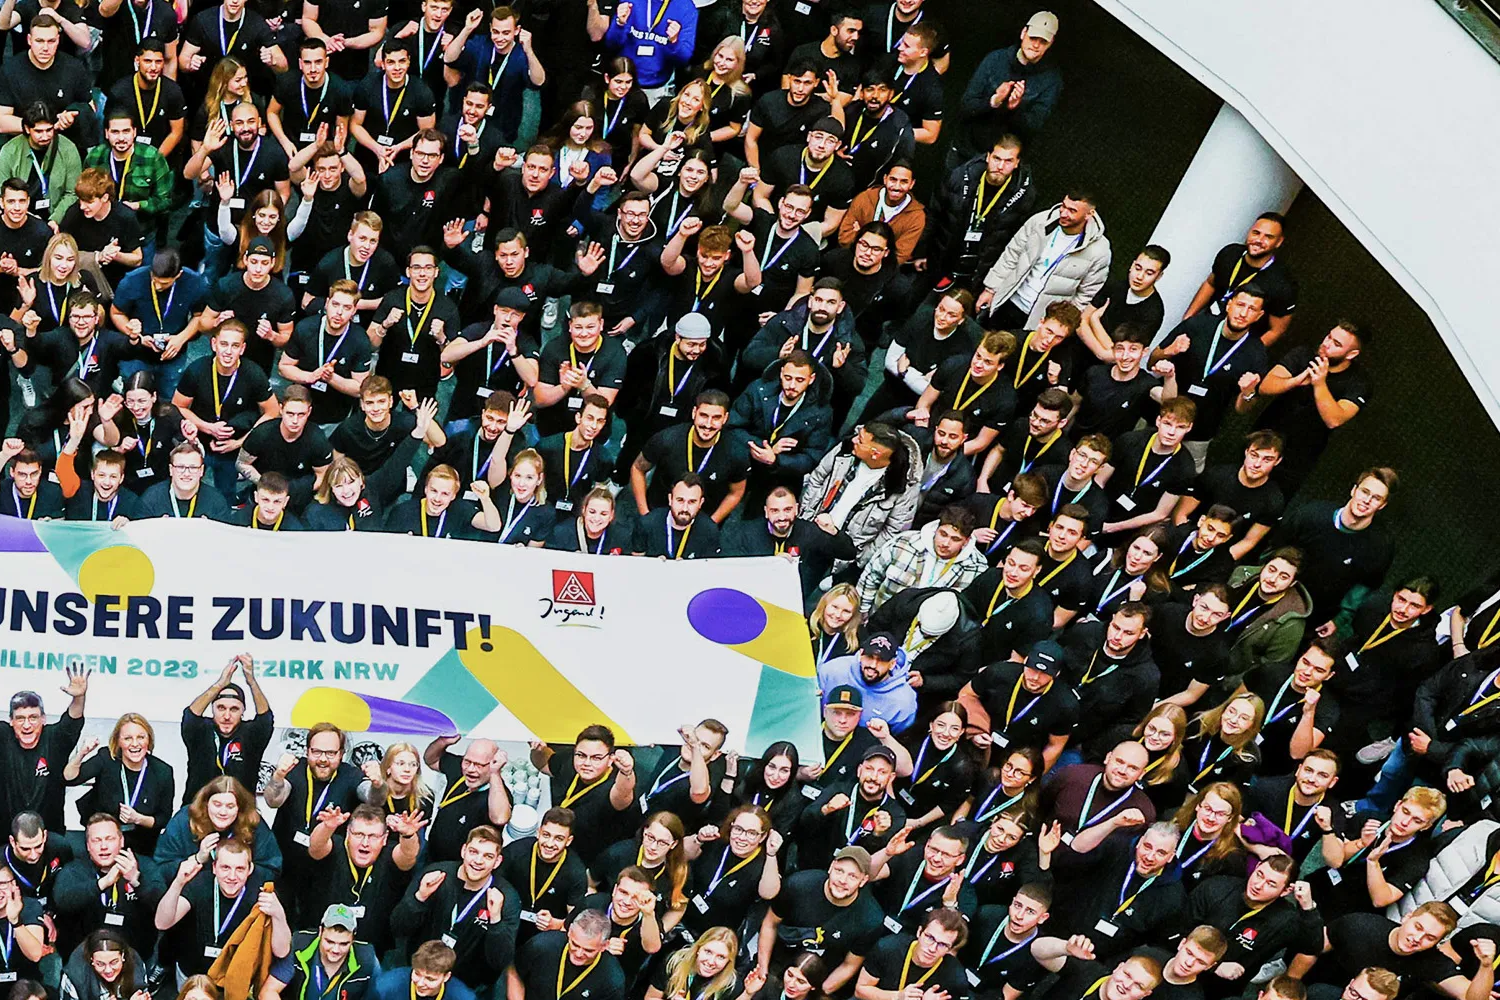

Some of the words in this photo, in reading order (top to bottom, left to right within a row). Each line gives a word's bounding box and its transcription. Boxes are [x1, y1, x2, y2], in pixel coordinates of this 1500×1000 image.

[211, 596, 494, 653] ZUKUNFT!
[127, 658, 199, 679] 2023
[228, 659, 324, 680] EZIRK
[334, 660, 400, 681] NRW
